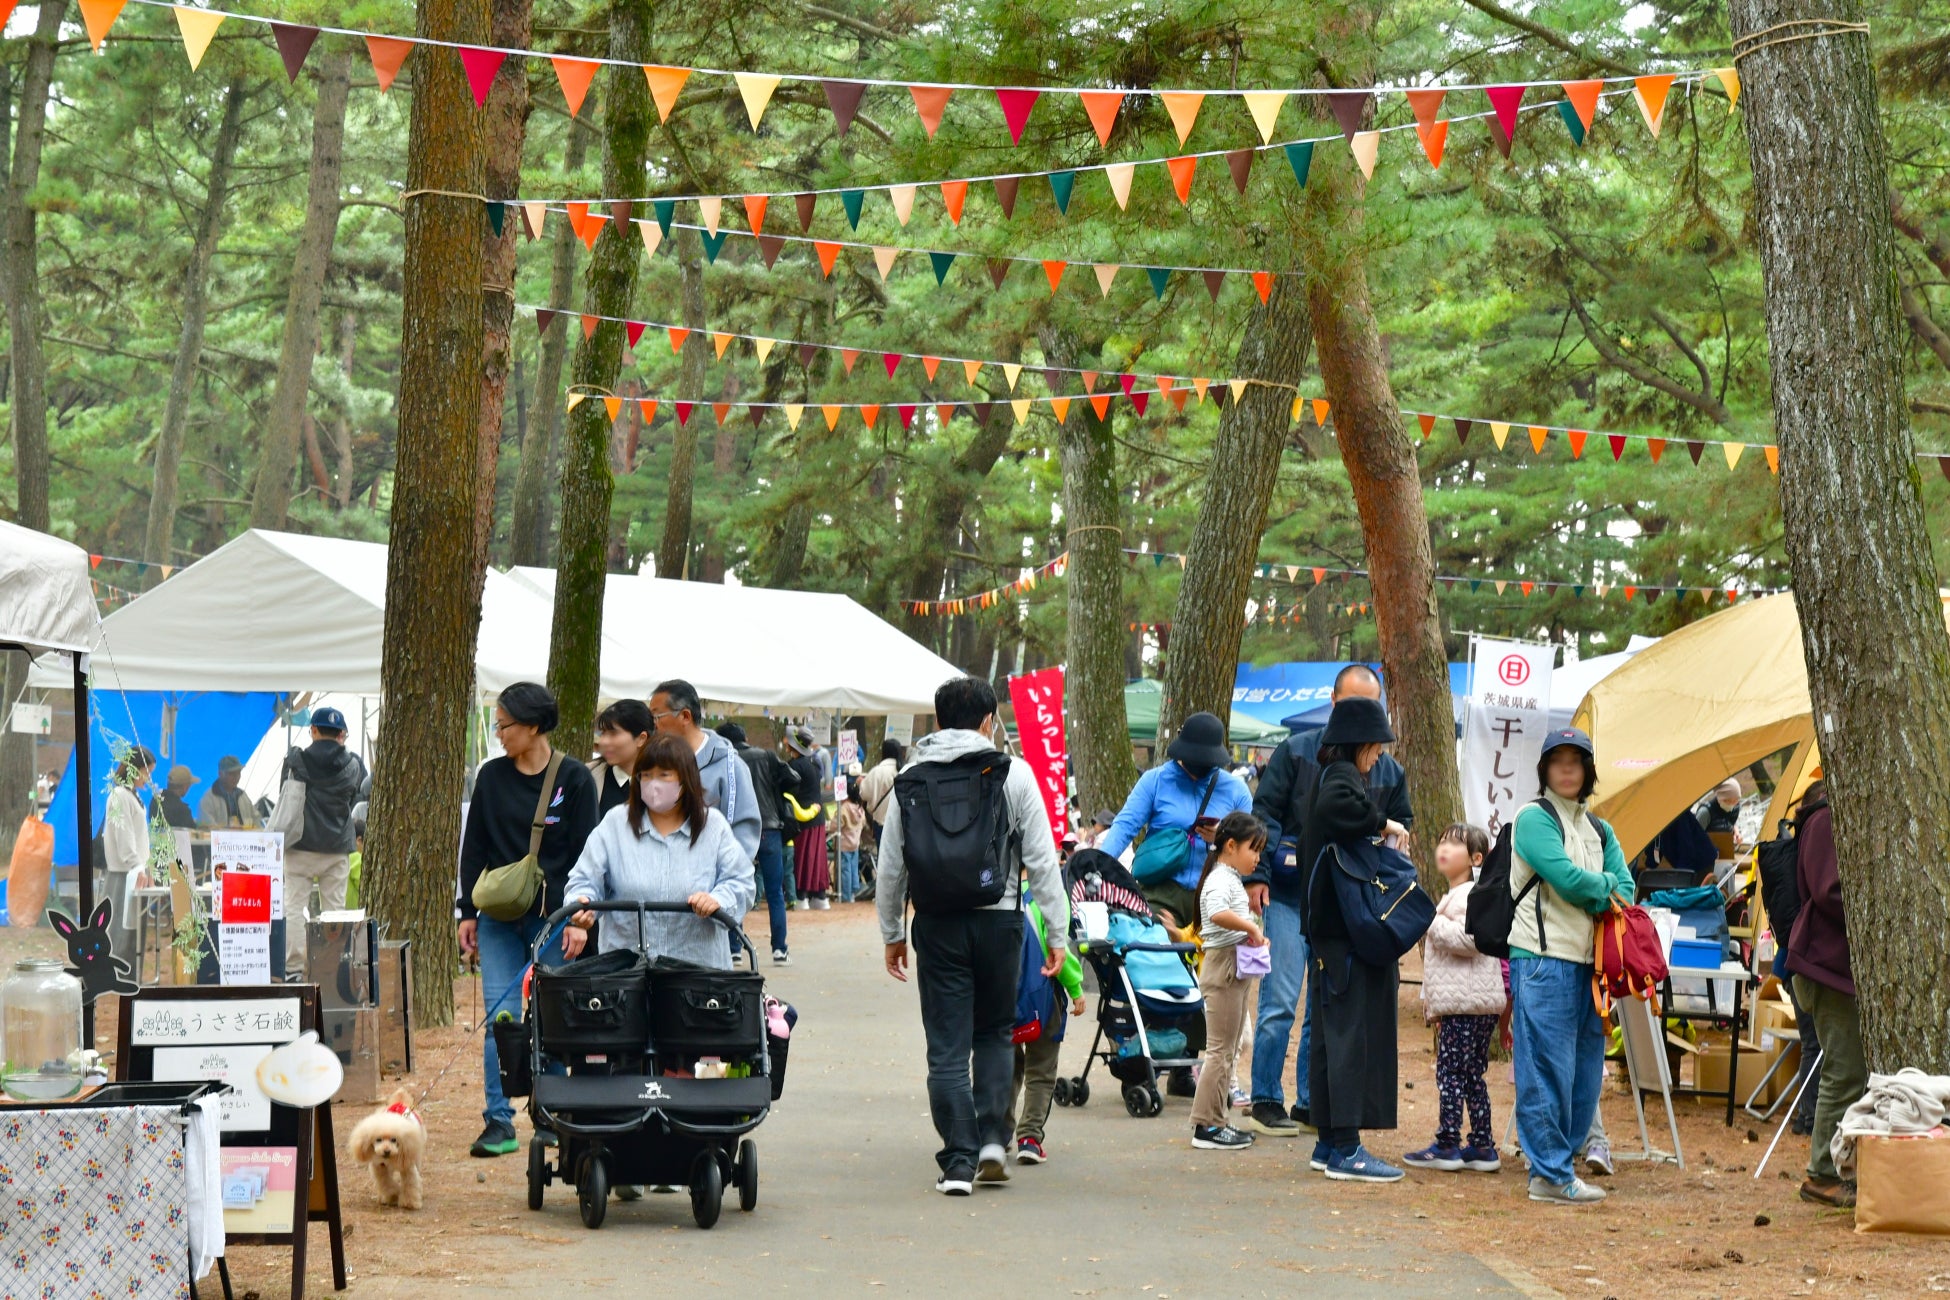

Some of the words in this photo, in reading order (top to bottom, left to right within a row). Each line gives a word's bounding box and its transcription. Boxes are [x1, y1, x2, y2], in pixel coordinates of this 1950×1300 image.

[1483, 692, 1538, 711] 茨城県産
[191, 1010, 295, 1032] うさぎ石鹸
